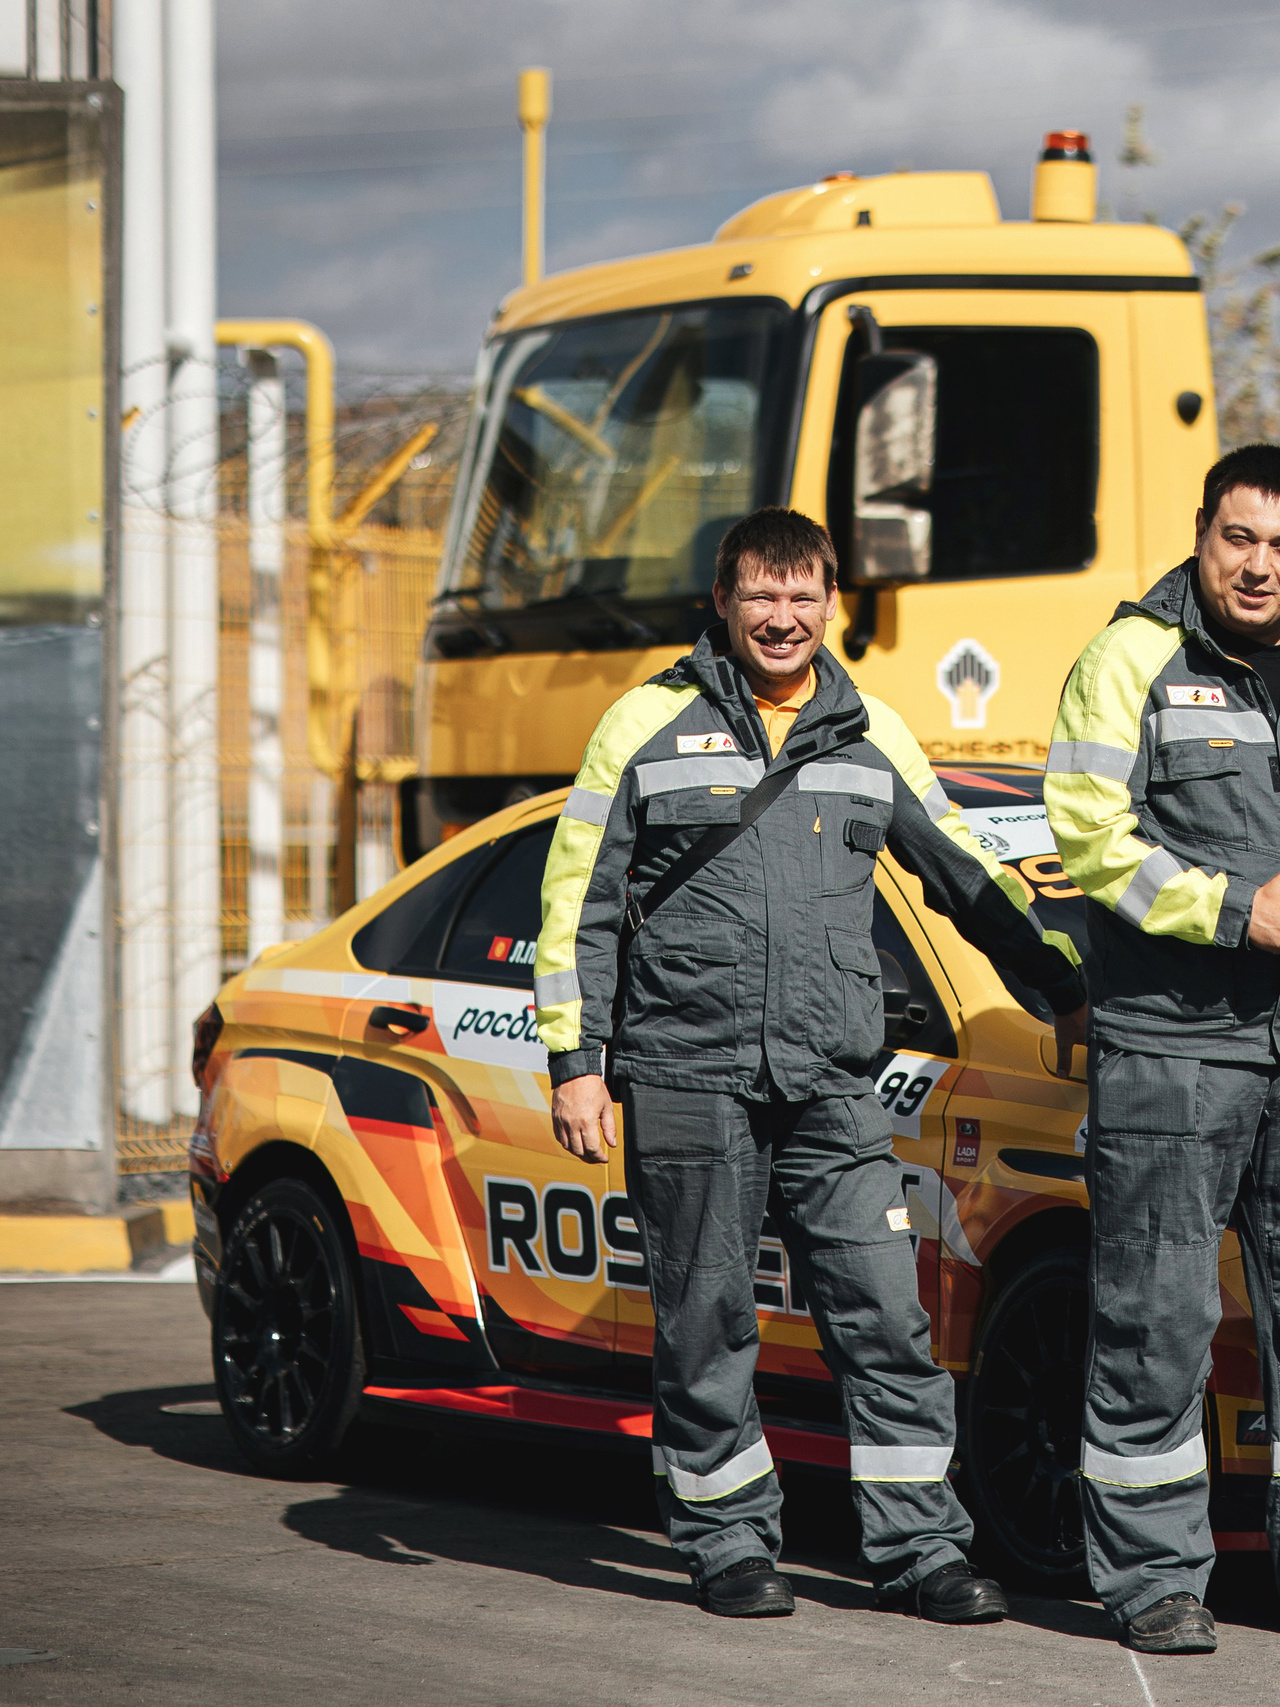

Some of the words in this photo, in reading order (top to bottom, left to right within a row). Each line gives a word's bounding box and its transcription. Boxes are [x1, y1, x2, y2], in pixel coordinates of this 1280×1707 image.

[917, 740, 1049, 758] СНЕФТЬ
[986, 813, 1048, 825] Росси
[880, 1071, 934, 1117] 99
[956, 1146, 977, 1157] LADA
